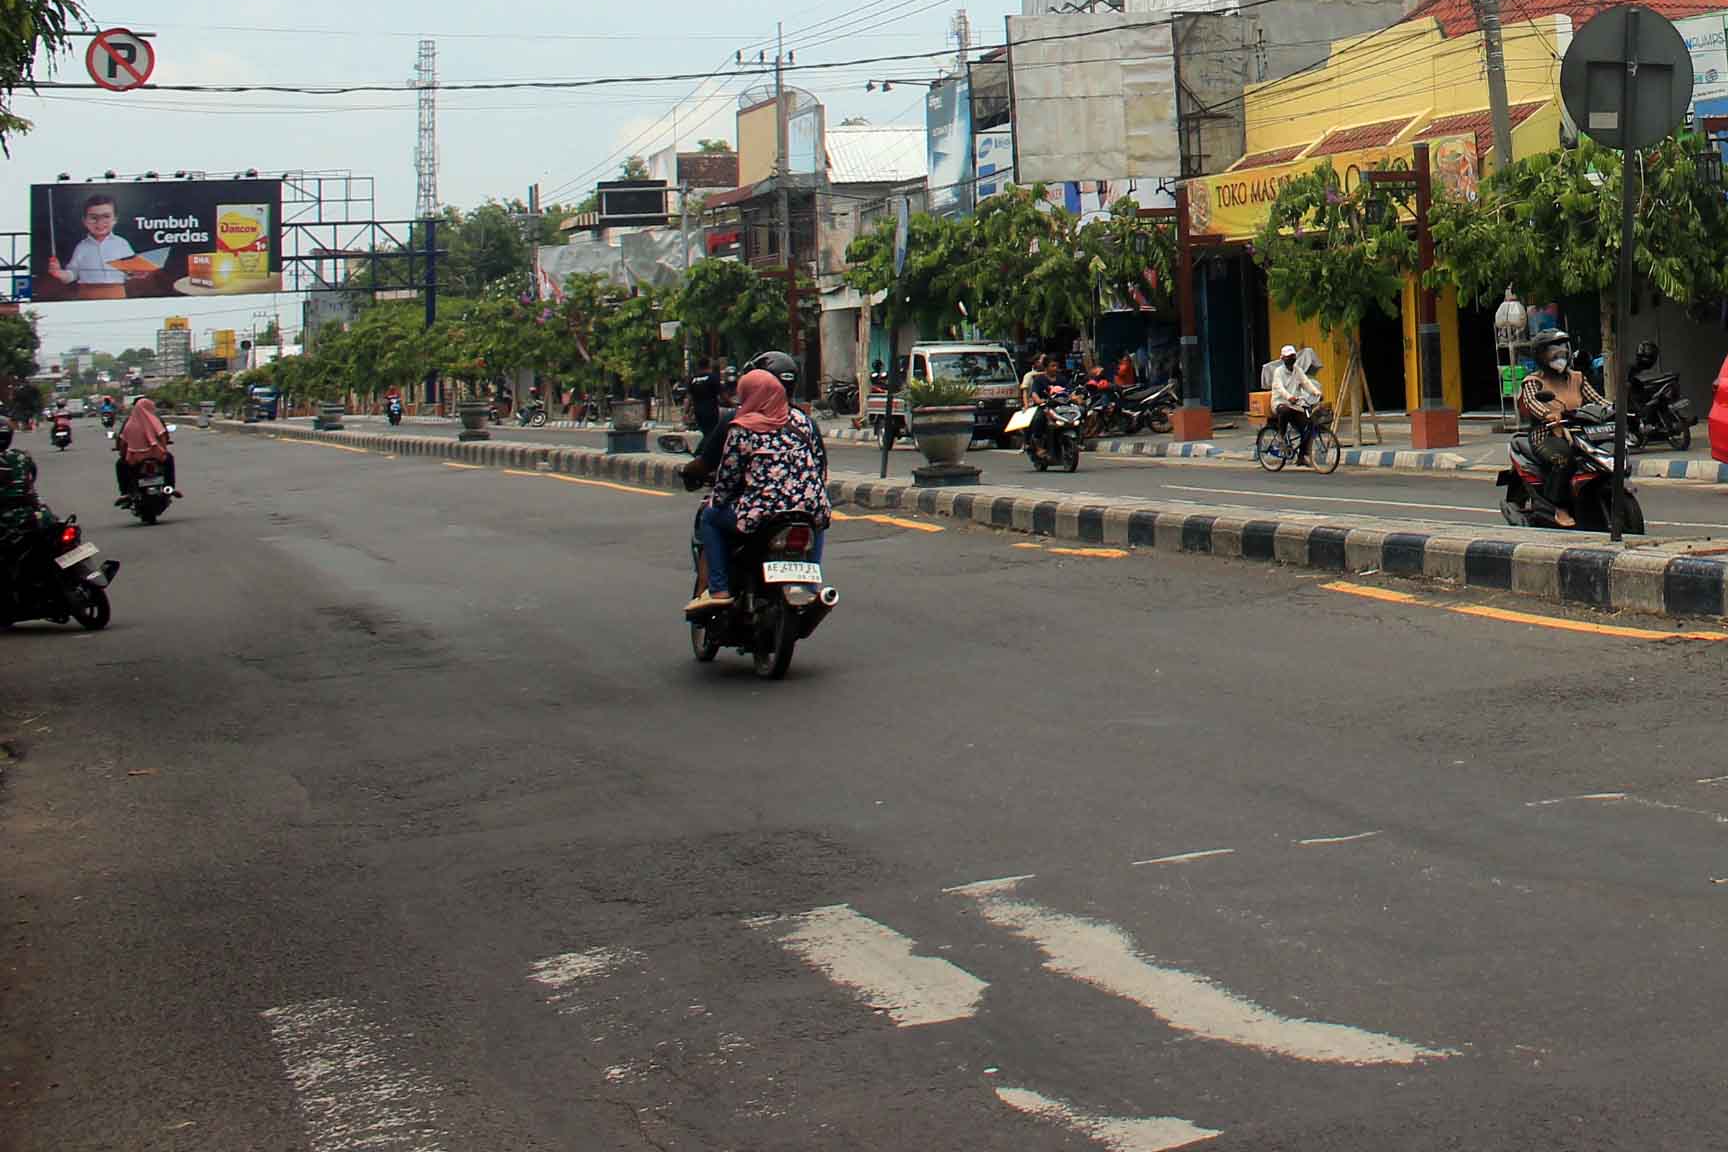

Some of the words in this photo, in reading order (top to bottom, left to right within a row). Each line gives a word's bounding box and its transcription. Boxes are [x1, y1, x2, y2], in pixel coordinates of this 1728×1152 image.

[107, 42, 137, 79] P
[1215, 181, 1248, 209] TOKO
[1250, 175, 1277, 203] MAS
[135, 215, 199, 230] Tumbuh
[153, 230, 209, 244] Cerdas
